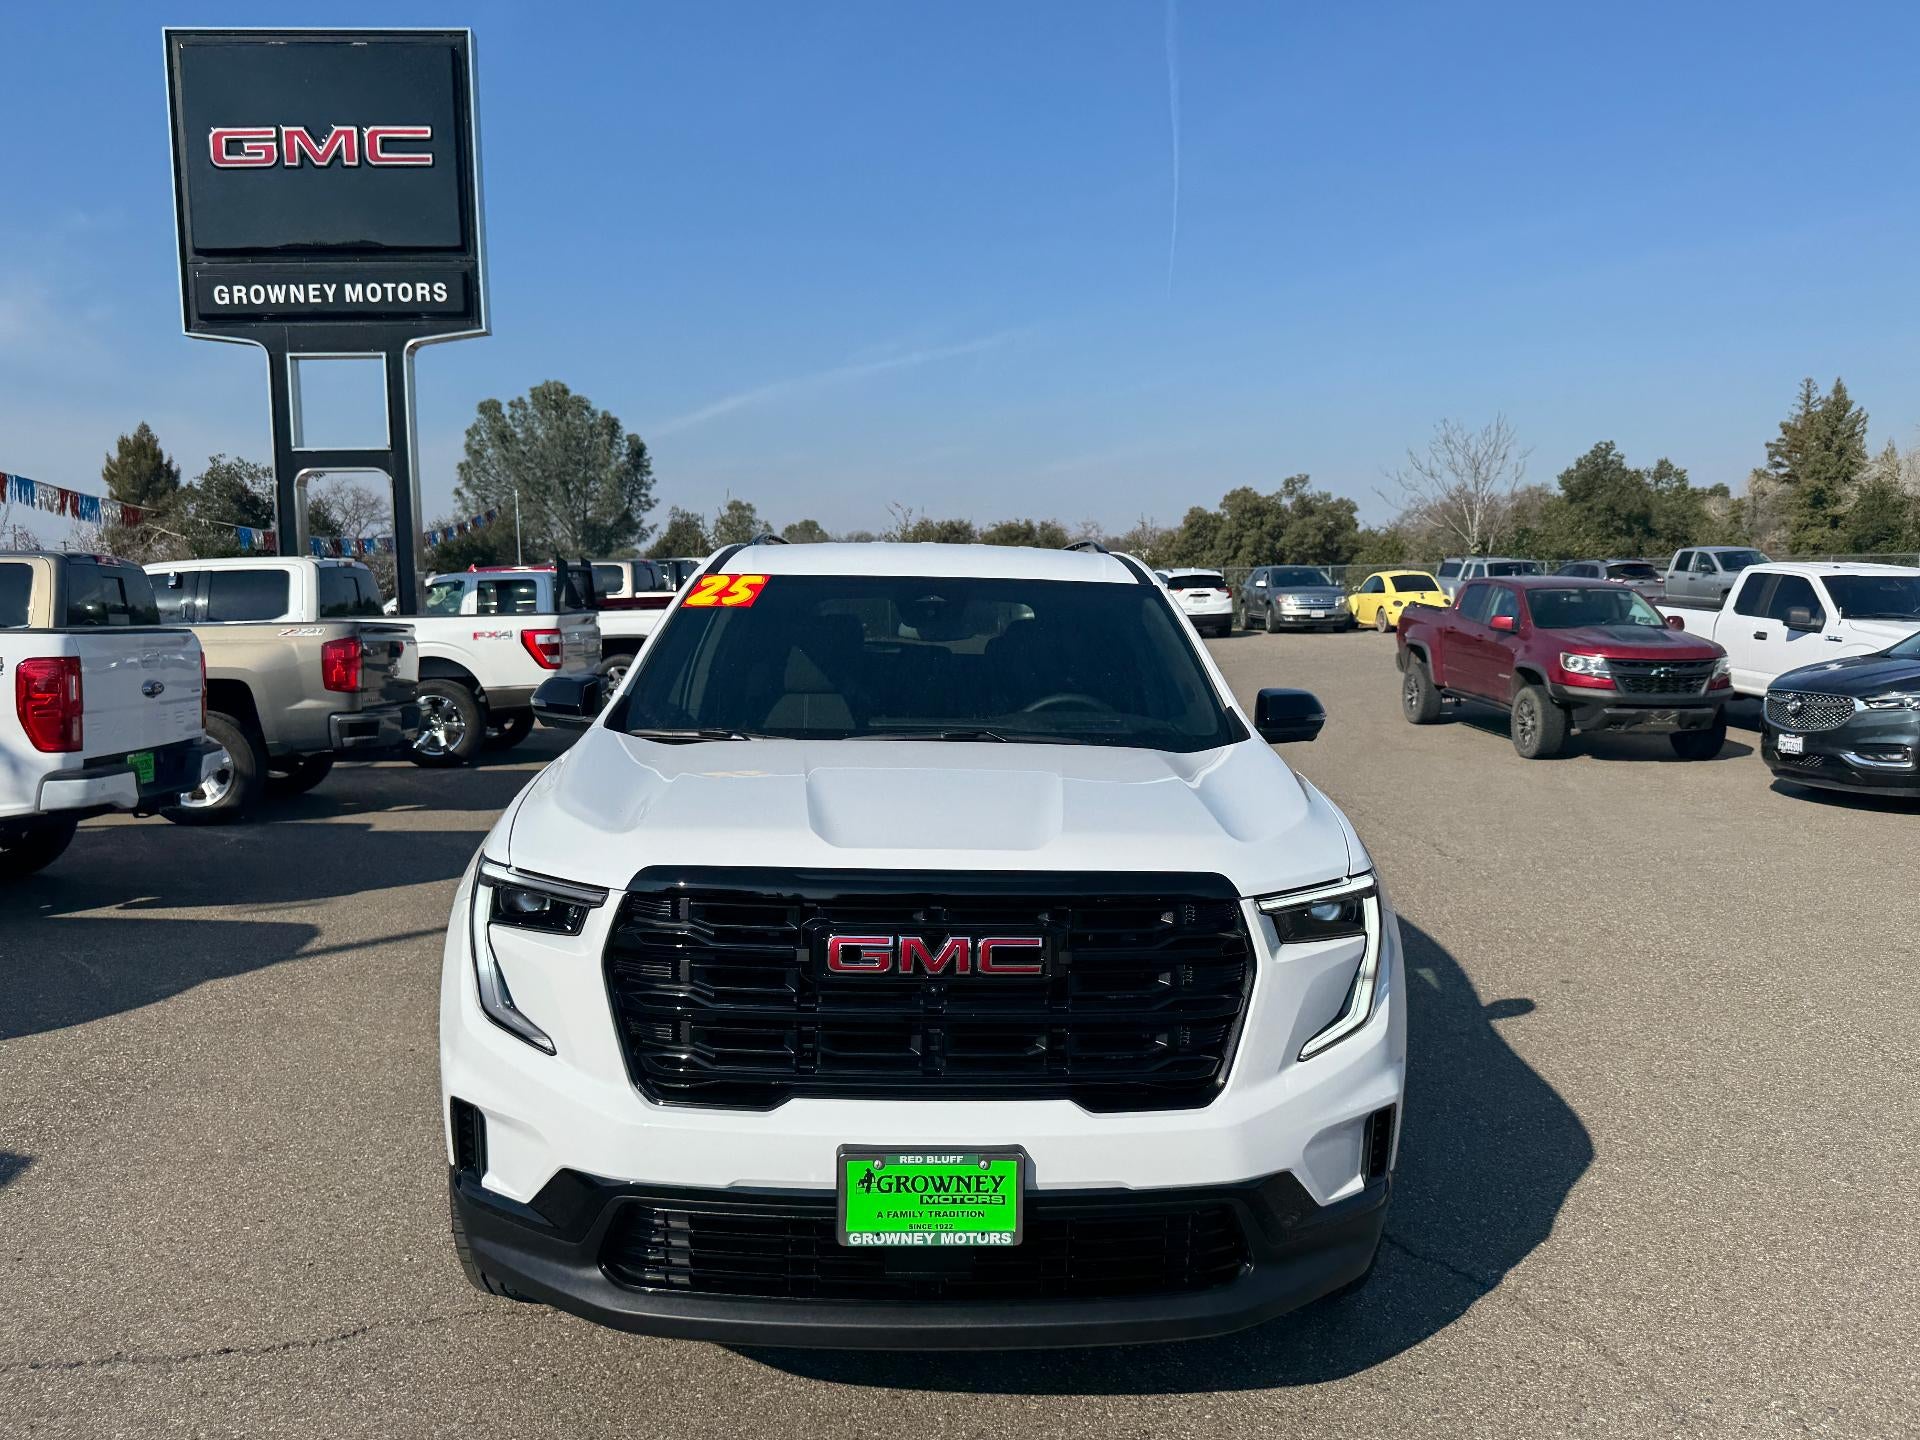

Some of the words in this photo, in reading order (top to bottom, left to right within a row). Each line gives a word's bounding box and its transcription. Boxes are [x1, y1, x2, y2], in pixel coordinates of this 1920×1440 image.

[209, 125, 433, 168] GMC
[213, 283, 336, 305] GROWNEY
[345, 282, 448, 303] MOTORS
[686, 575, 765, 606] 25
[827, 935, 1043, 975] GMC
[900, 1156, 923, 1164] RED
[926, 1156, 964, 1164] BLUFF
[877, 1175, 1006, 1194] GROWNEY
[922, 1195, 1004, 1204] MOTORS
[928, 1210, 985, 1218] TRADITION
[850, 1232, 936, 1245] GROWNEY
[940, 1232, 1012, 1245] MOTORS
